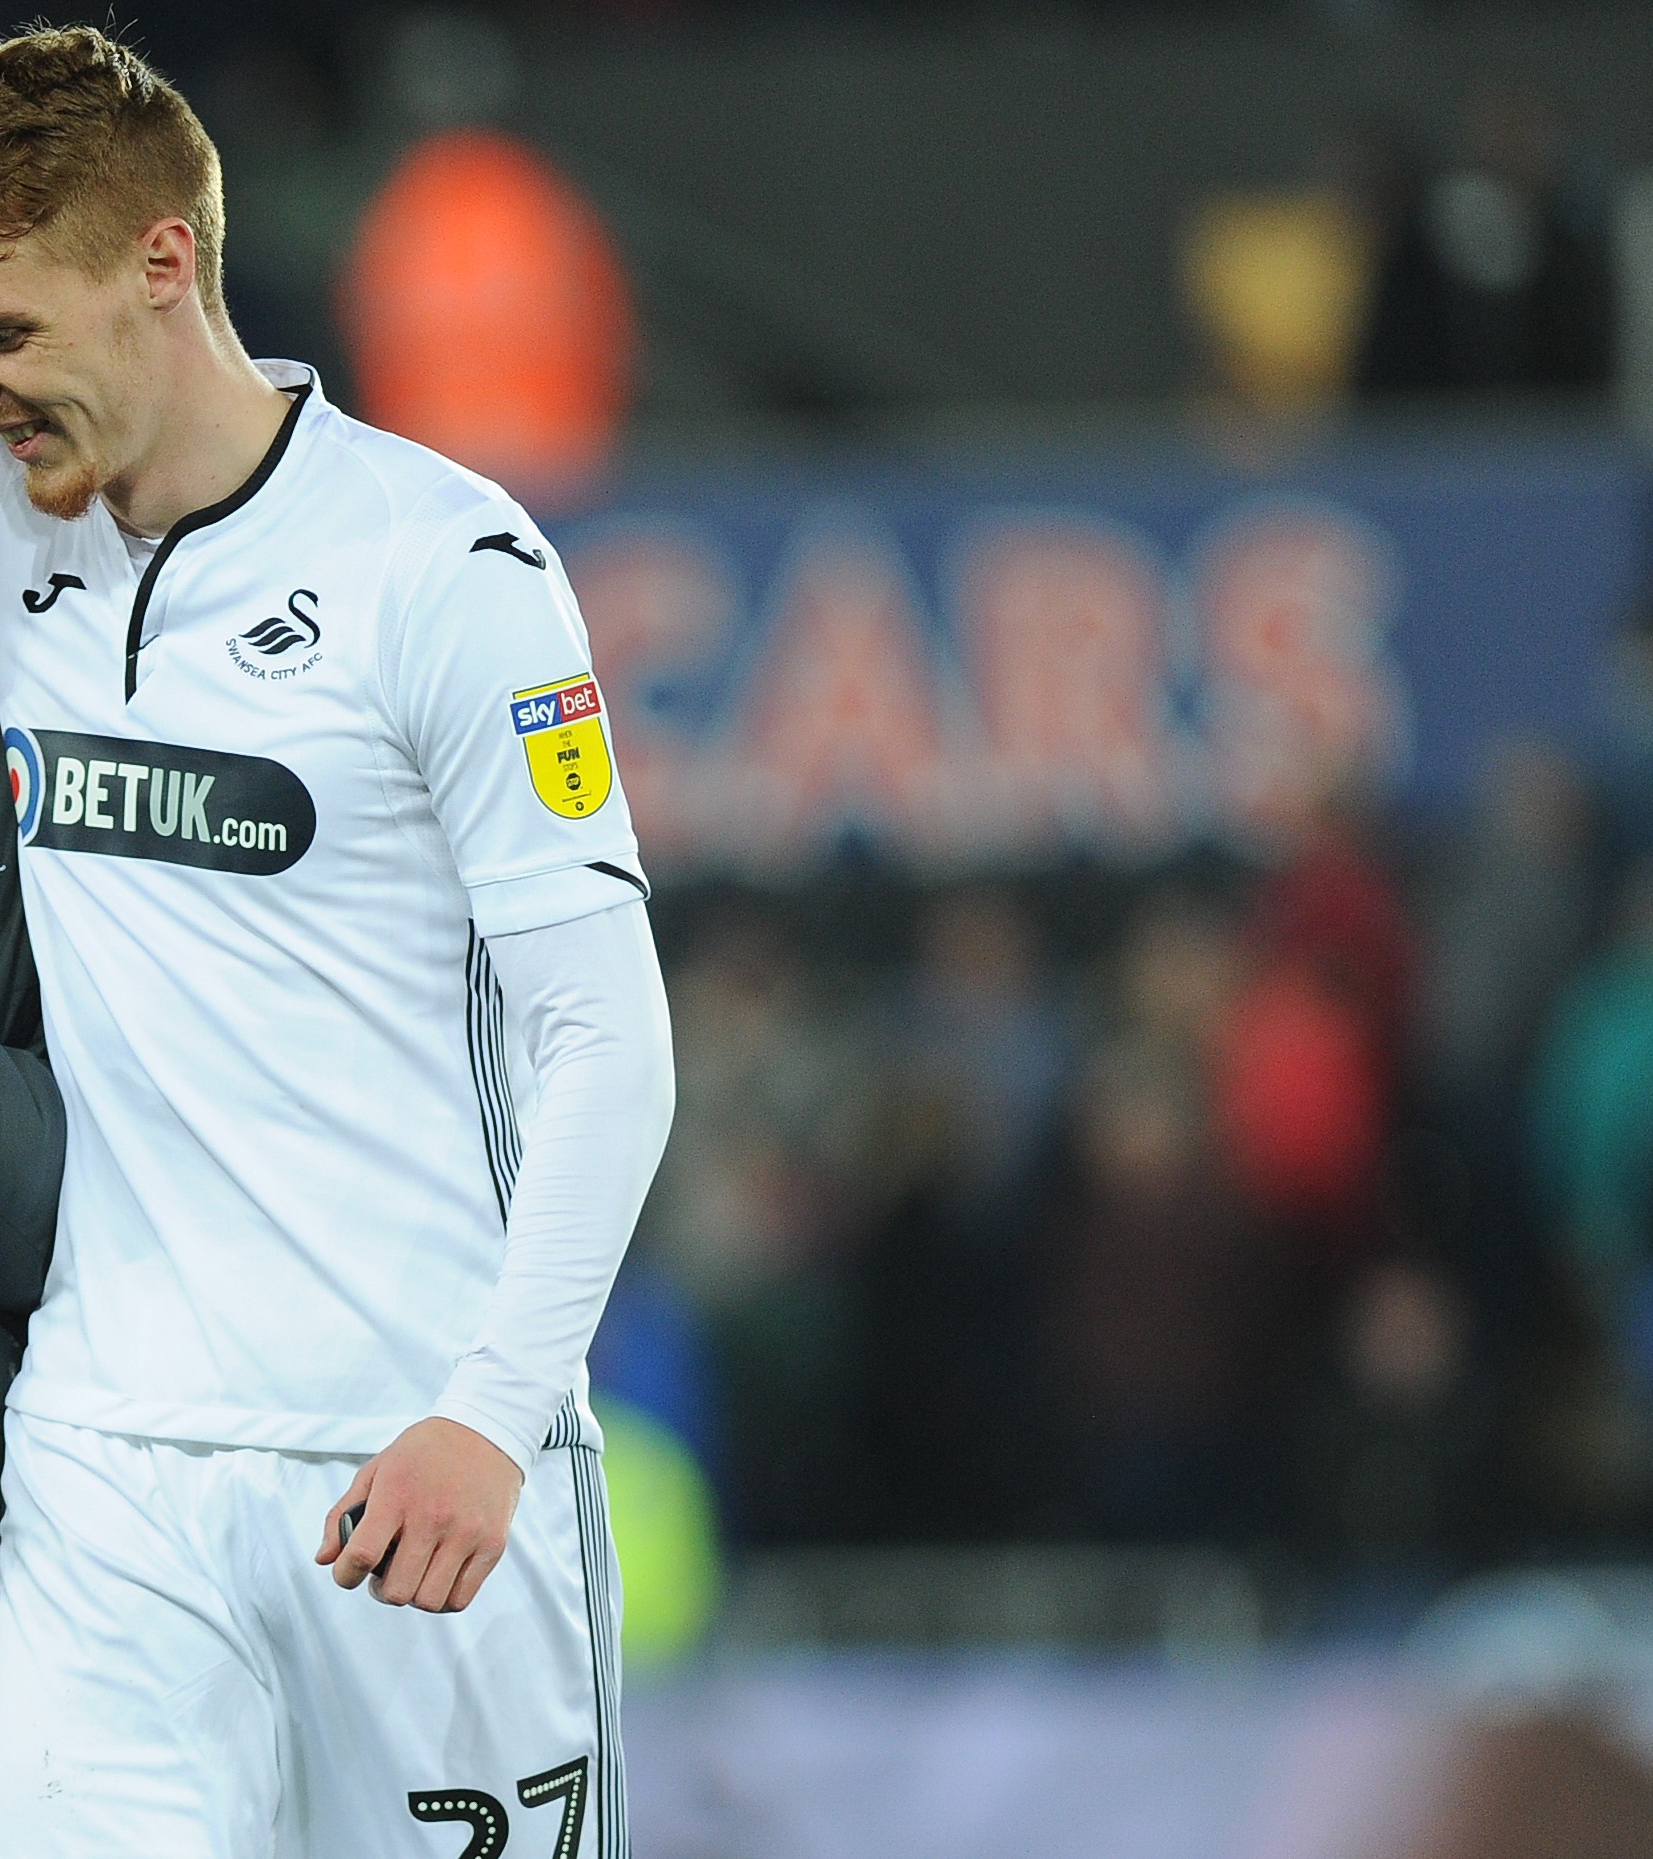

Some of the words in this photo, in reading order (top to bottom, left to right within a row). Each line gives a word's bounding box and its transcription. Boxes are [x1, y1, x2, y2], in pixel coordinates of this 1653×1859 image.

[226, 638, 266, 680] SWANSEA
[270, 667, 297, 680] CITY
[302, 652, 323, 672] AFC
[517, 700, 556, 727] sky
[560, 687, 596, 715] bet
[557, 748, 580, 763] FUN
[52, 756, 287, 852] BETUK.com
[407, 1755, 589, 1859] 27
